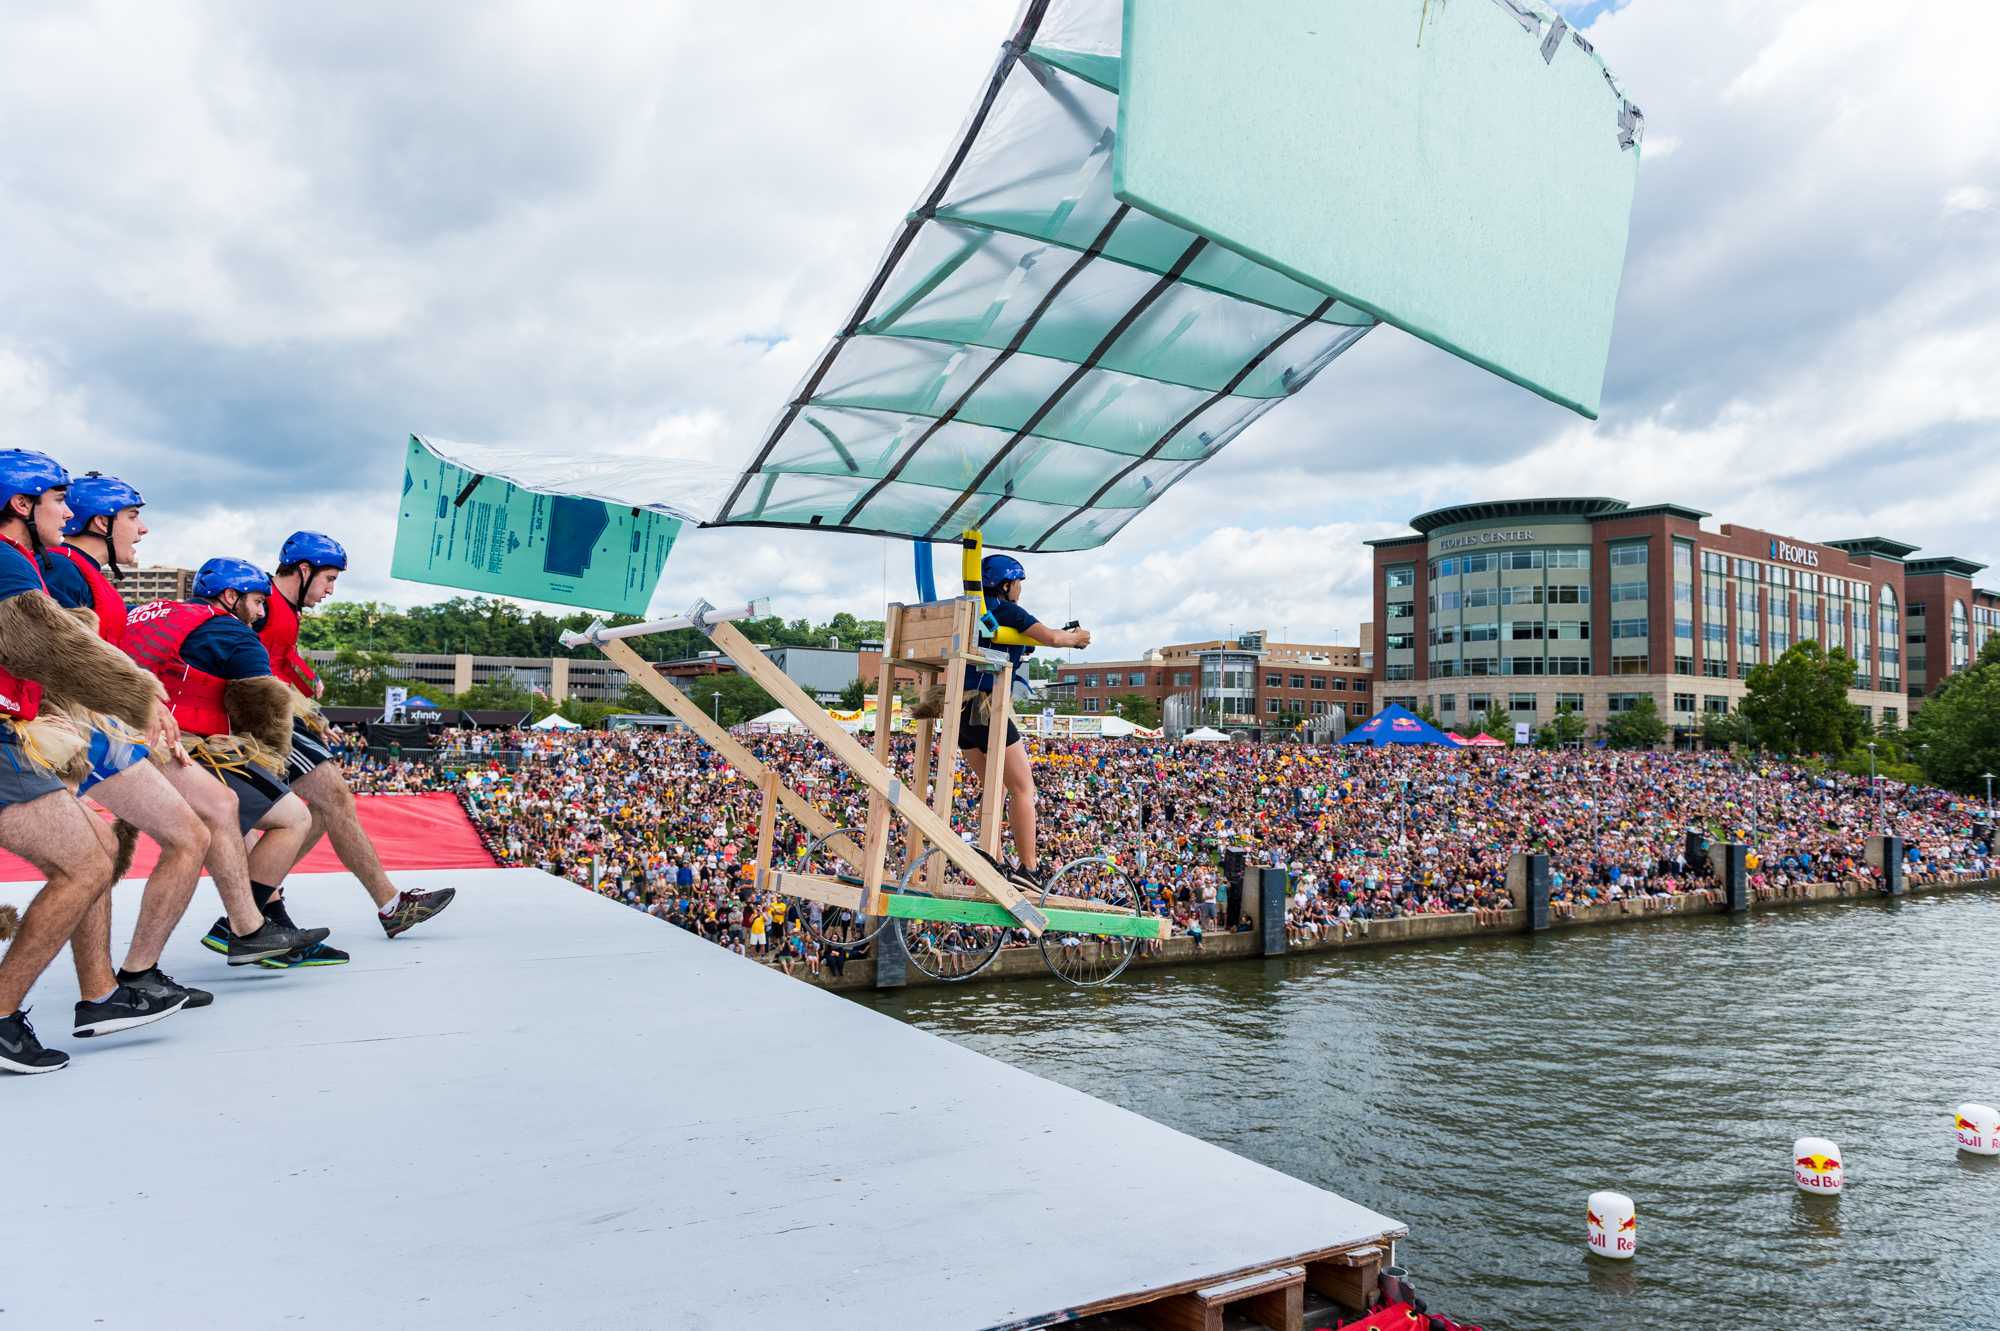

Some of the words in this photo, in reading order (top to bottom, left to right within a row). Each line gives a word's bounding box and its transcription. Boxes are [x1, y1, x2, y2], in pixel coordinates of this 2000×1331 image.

[1480, 529, 1536, 544] CENTER
[1779, 540, 1819, 567] PEOPLES
[410, 710, 442, 721] xfinity
[1795, 1170, 1820, 1187] Red
[1823, 1175, 1842, 1188] Bu
